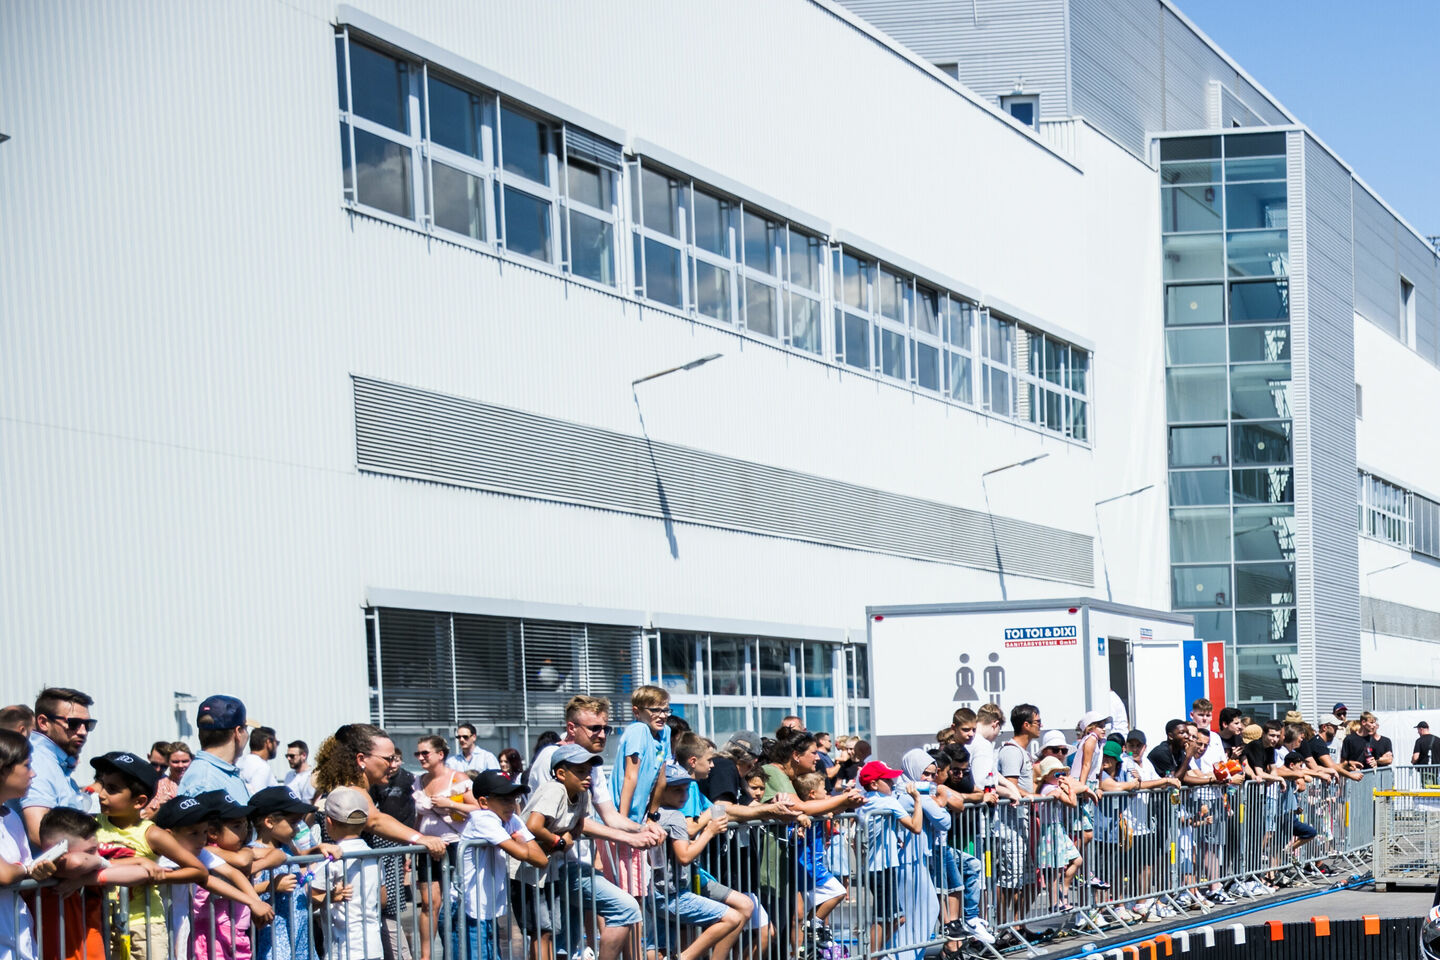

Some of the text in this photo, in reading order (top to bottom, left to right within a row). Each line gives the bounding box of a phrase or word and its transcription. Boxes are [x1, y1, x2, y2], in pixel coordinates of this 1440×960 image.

[1006, 627, 1075, 639] TOI TOI & DIXI
